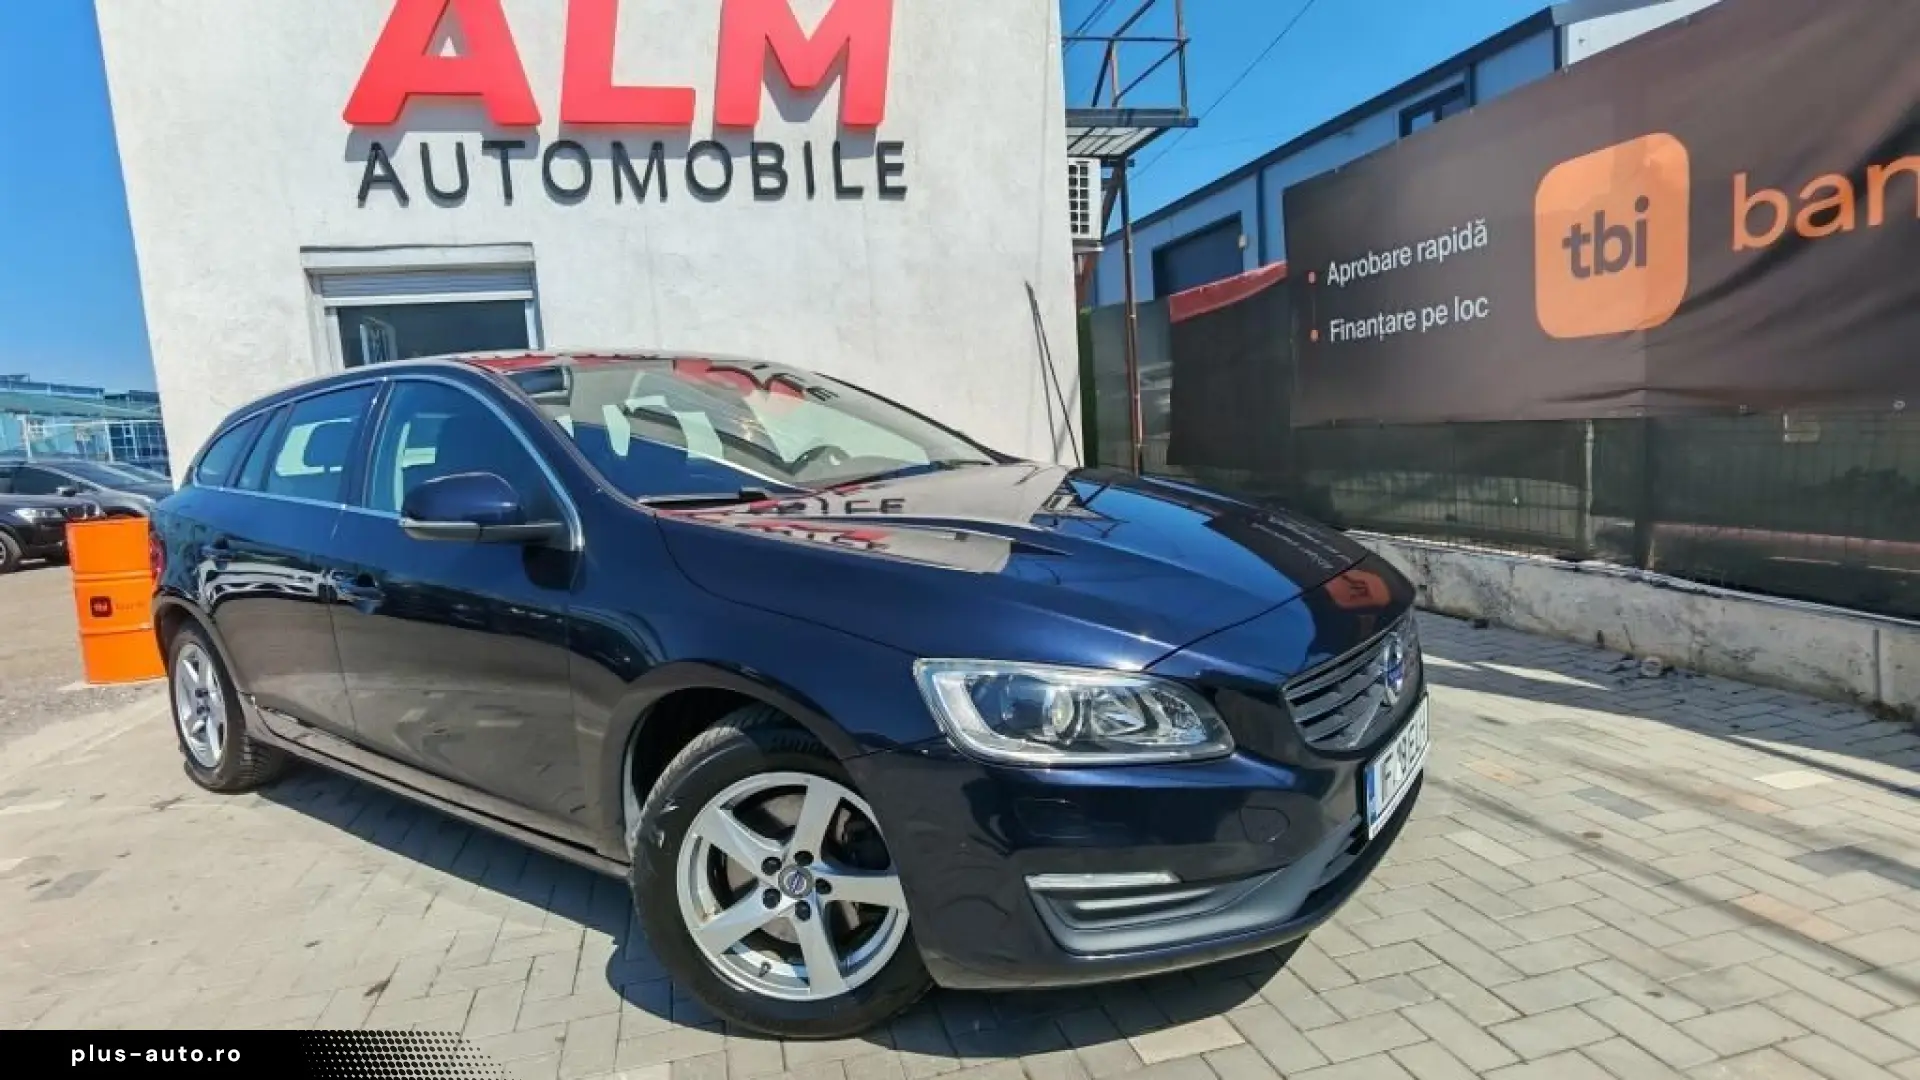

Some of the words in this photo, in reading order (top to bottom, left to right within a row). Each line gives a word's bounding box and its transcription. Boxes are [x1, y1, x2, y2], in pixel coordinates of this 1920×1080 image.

[343, 0, 893, 127] ALM
[358, 138, 907, 207] AUTOMOBILE
[1327, 245, 1412, 288] Aprobare
[1416, 217, 1488, 263] rapidă
[1562, 194, 1649, 278] tbi
[1329, 309, 1417, 343] Finanțare
[1421, 302, 1449, 333] pe
[1454, 295, 1489, 323] loc
